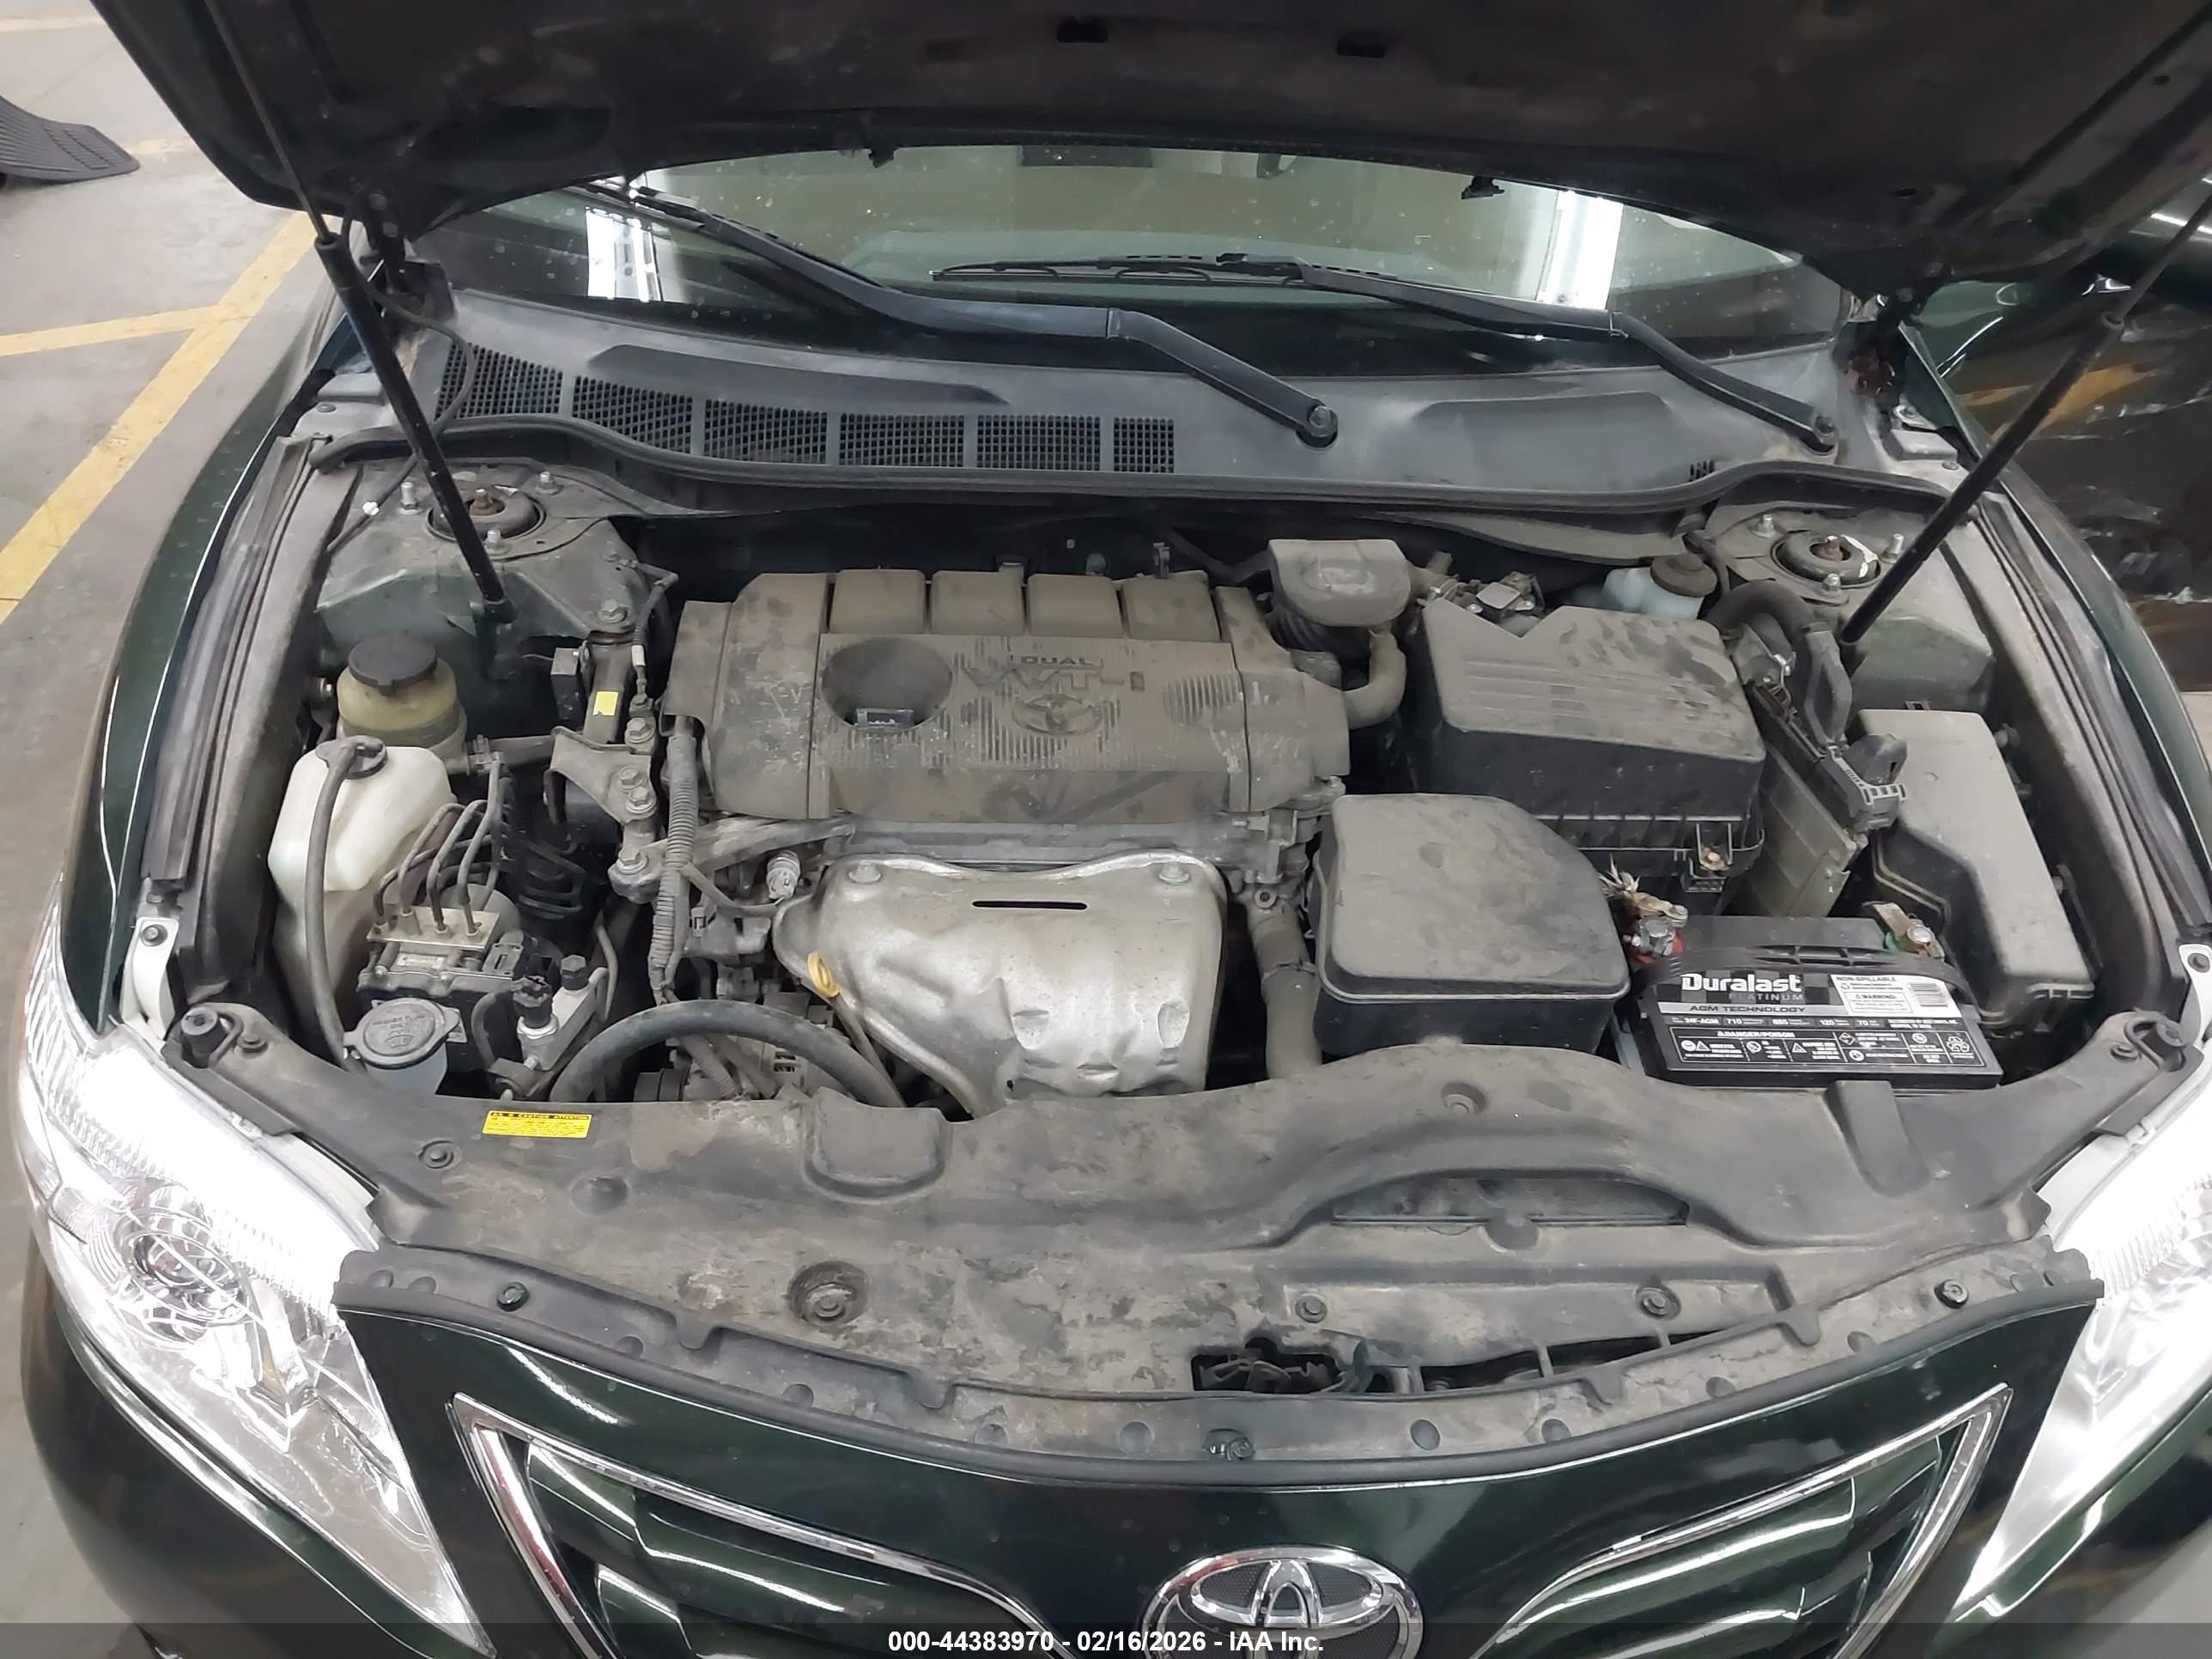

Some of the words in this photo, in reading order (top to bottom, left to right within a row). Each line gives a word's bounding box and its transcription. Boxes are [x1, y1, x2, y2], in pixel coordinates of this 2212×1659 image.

[1021, 656, 1093, 665] DUAL
[1679, 972, 1802, 993] Duralast
[1729, 993, 1804, 1002] PLATINUM
